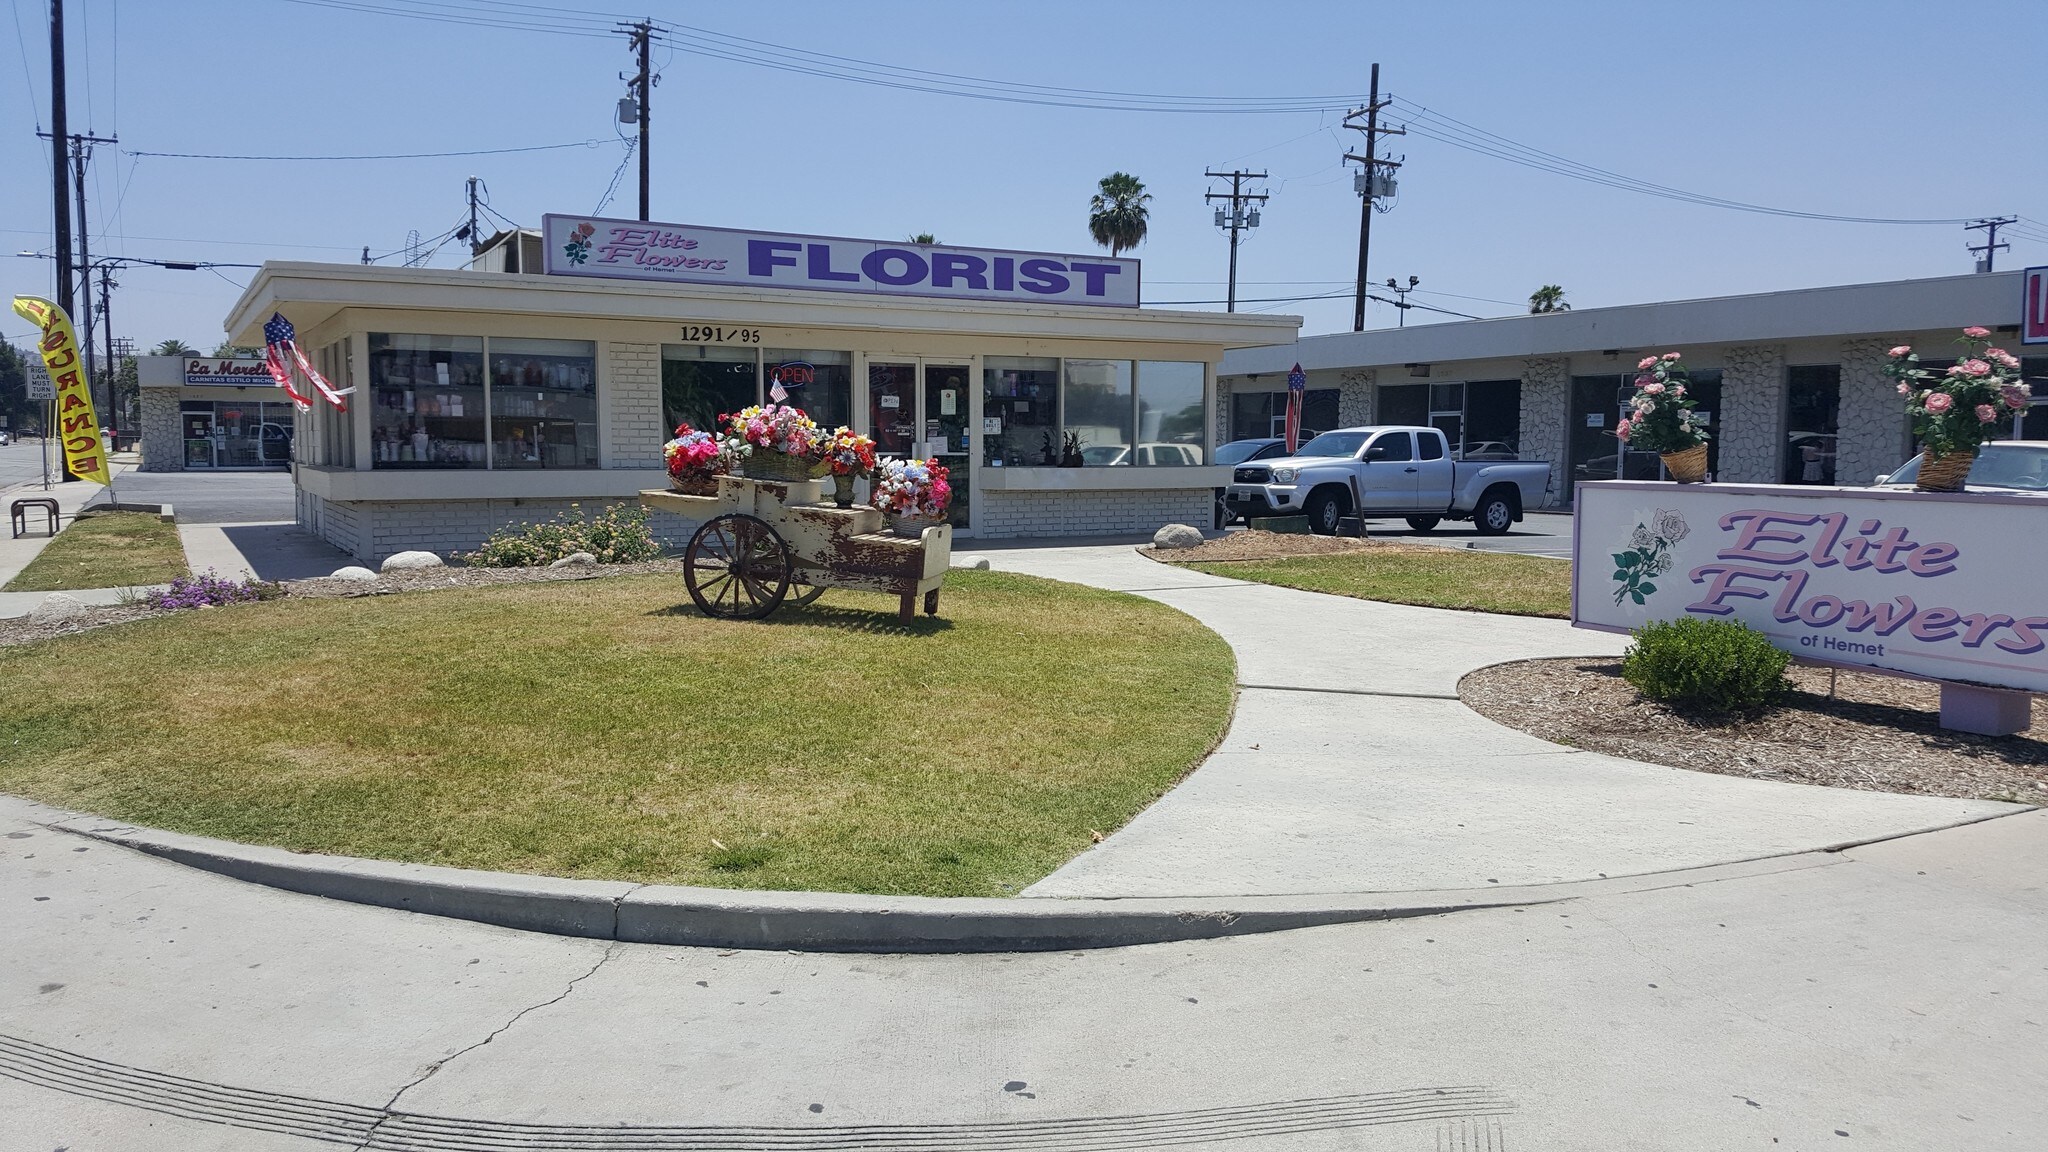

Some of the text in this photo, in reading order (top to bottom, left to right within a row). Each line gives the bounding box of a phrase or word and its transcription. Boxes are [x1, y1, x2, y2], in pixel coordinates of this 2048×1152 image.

[610, 228, 698, 250] Elite
[597, 245, 728, 270] Flowers
[747, 239, 1121, 296] FLORIST
[186, 360, 210, 375] La
[770, 366, 815, 383] OPEN
[1717, 509, 1959, 578] Elite
[1685, 563, 2048, 655] Flowers
[1800, 633, 1885, 657] of Hemet
